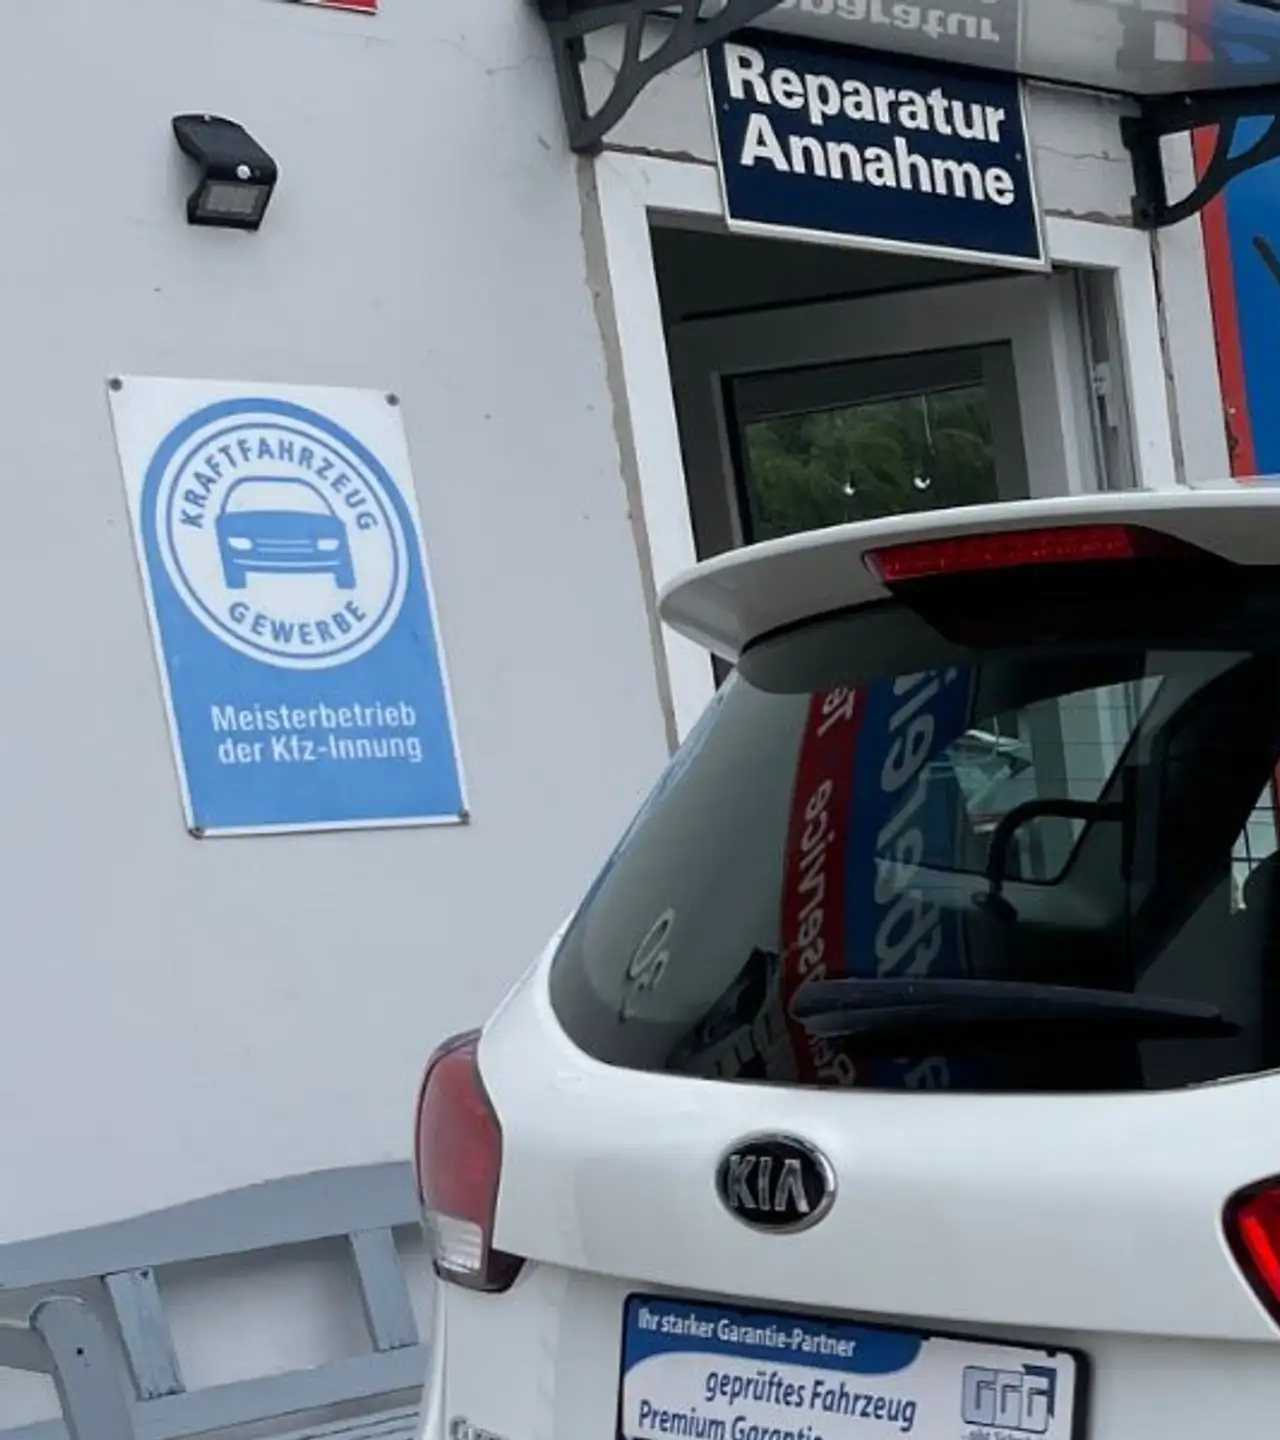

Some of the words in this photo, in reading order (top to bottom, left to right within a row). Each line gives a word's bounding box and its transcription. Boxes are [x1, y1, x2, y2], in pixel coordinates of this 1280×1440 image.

[723, 42, 1006, 143] Reparatur
[739, 112, 1016, 206] Annahme
[179, 437, 379, 532] KRAFTFAHRZEUG
[227, 598, 368, 647] GEWERBE
[210, 702, 417, 731] Meisterbetrieb
[218, 736, 262, 763] der
[271, 735, 423, 764] Kfz-Innung
[727, 1152, 811, 1214] KIA
[637, 1306, 660, 1331] Ihr
[660, 1311, 716, 1339] starker
[717, 1318, 857, 1358] Garantie-Partner
[704, 1368, 807, 1410] geprüftes
[808, 1380, 918, 1433] Fahrzeug
